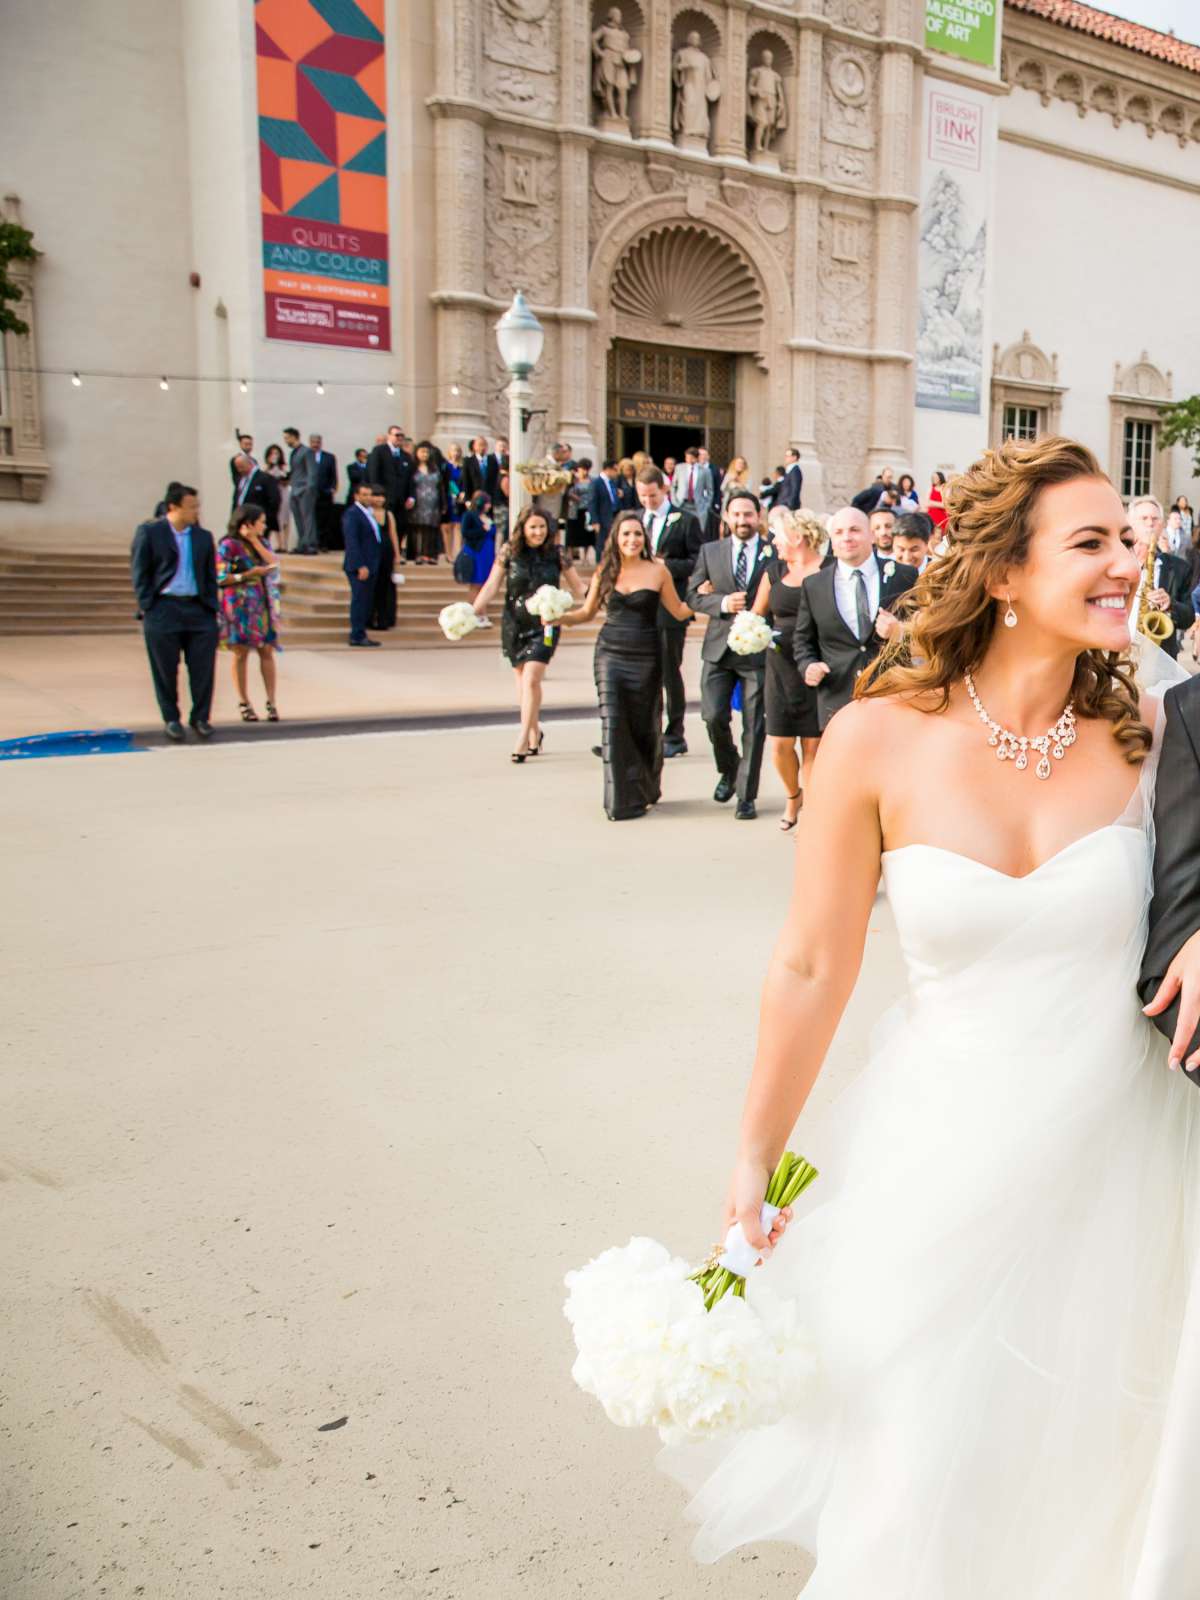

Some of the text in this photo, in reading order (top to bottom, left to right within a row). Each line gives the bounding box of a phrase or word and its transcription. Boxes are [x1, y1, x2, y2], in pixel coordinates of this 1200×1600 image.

[927, 0, 980, 28] MUSEUM
[927, 17, 971, 42] OF ART
[936, 101, 977, 120] BRUSH
[944, 119, 976, 144] INK
[292, 227, 361, 252] QUILTS
[271, 245, 311, 266] AND
[316, 252, 382, 275] COLOR
